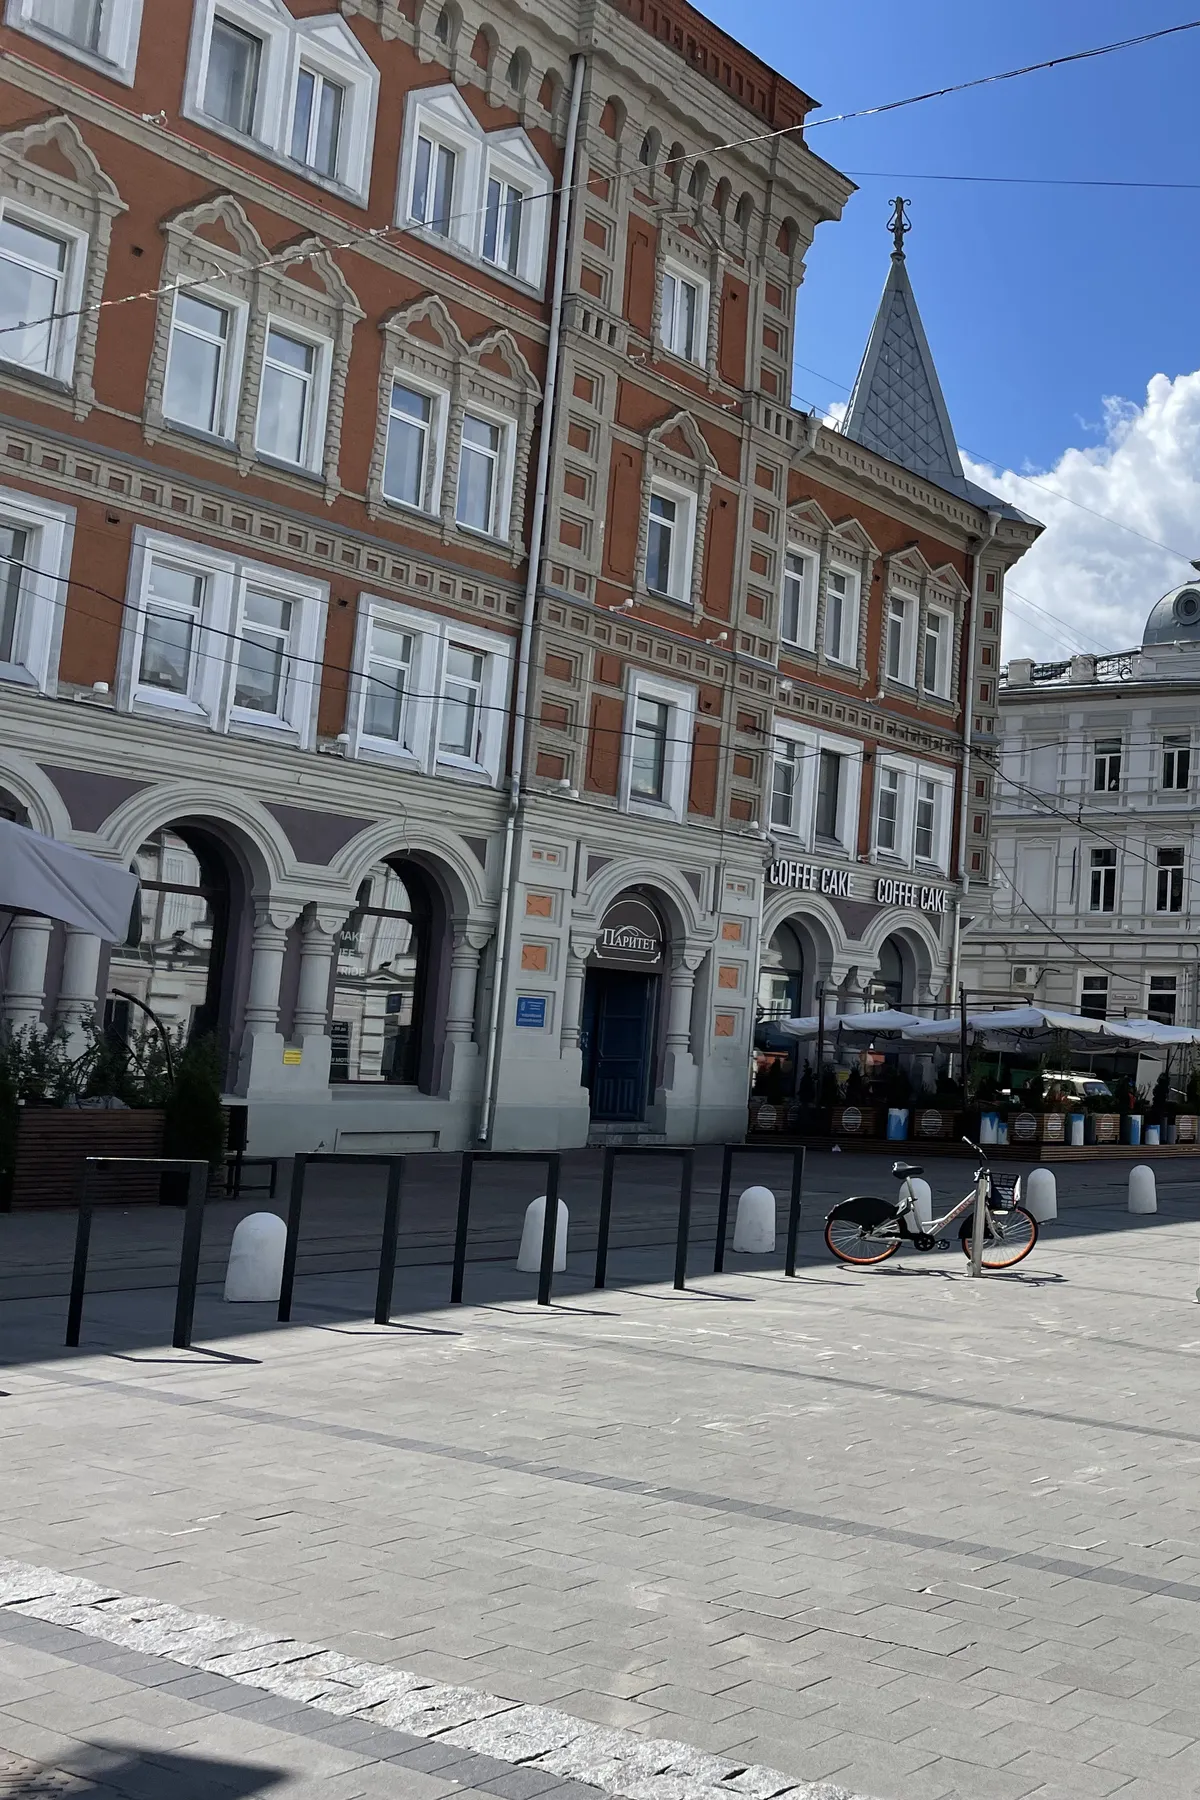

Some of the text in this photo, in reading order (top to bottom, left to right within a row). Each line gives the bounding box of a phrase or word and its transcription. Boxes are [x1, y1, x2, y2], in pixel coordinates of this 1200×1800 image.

[770, 860, 853, 897] COFFEE CAKE
[877, 878, 949, 913] COFFEE CAKE
[602, 928, 656, 950] ПАРИТЕТ
